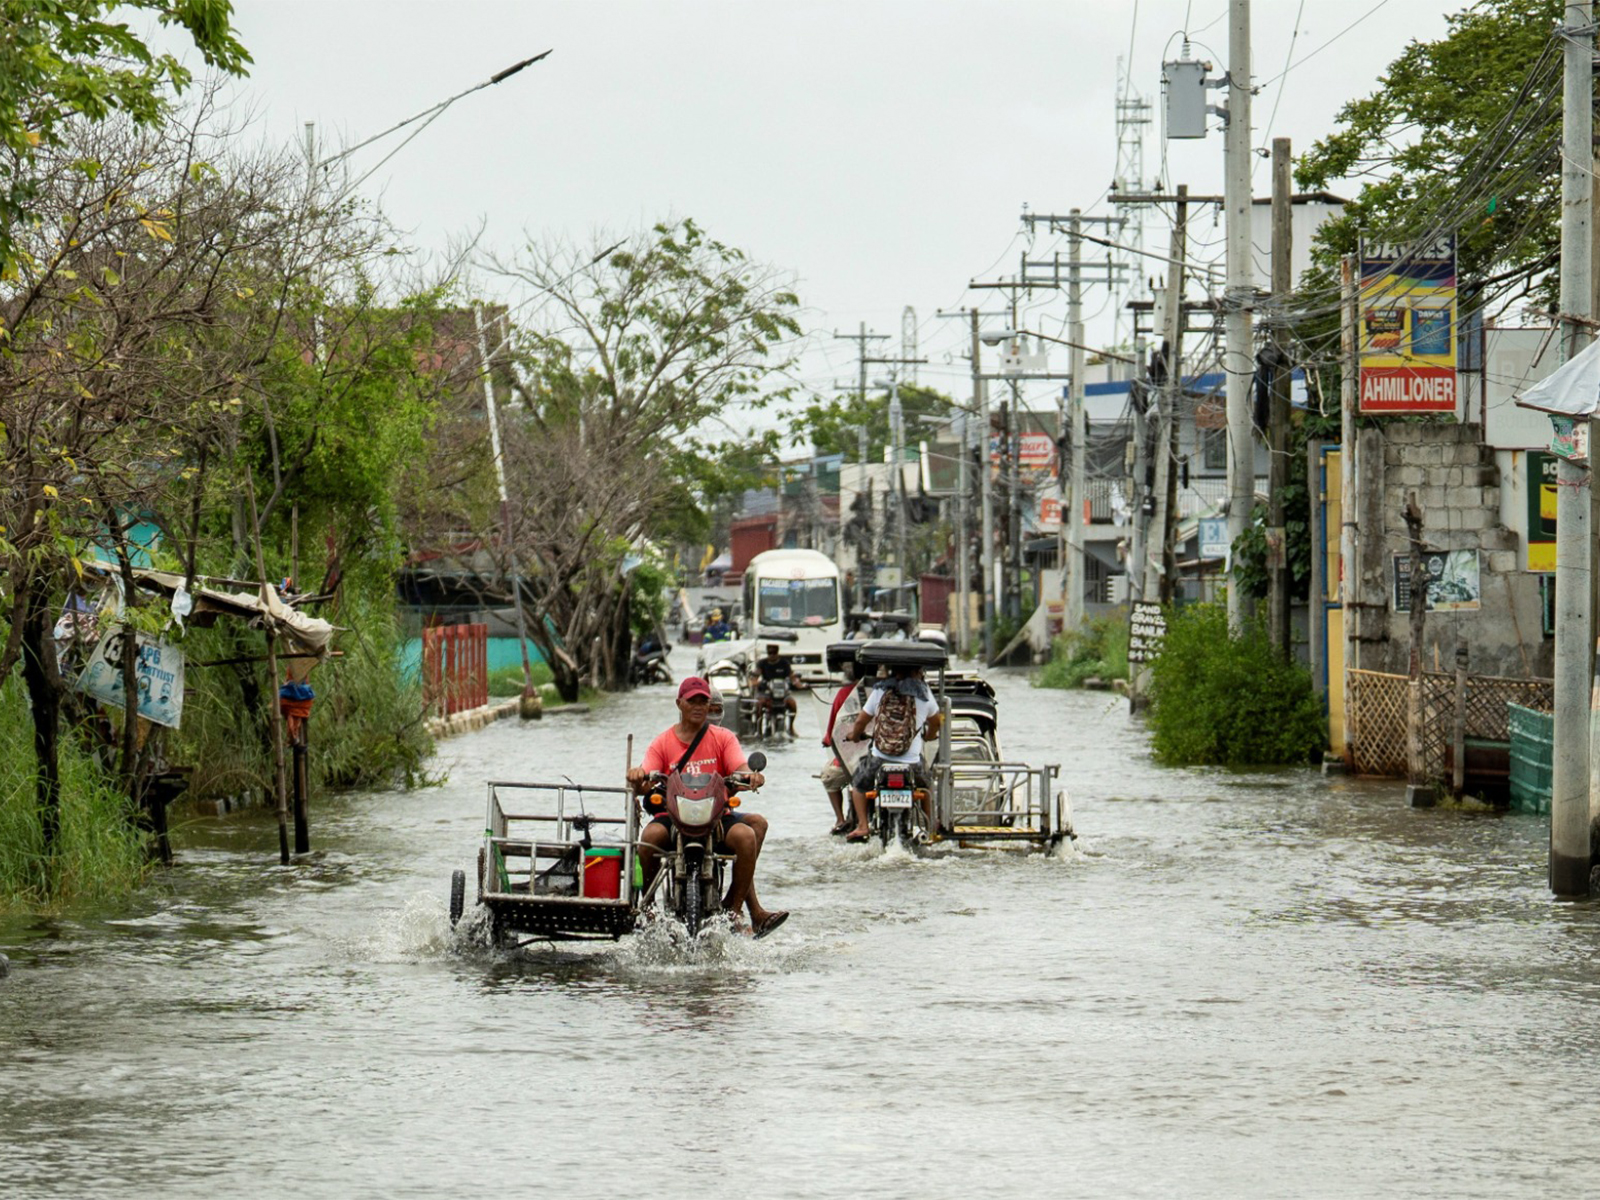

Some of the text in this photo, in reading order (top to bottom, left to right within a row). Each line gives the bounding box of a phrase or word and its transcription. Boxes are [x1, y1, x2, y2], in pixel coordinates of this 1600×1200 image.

[1363, 377, 1454, 402] AHMILIONER
[1134, 603, 1161, 614] SAND
[1131, 612, 1166, 626] GRAVEL
[140, 645, 161, 665] LPG
[137, 662, 175, 683] PARTYLIST
